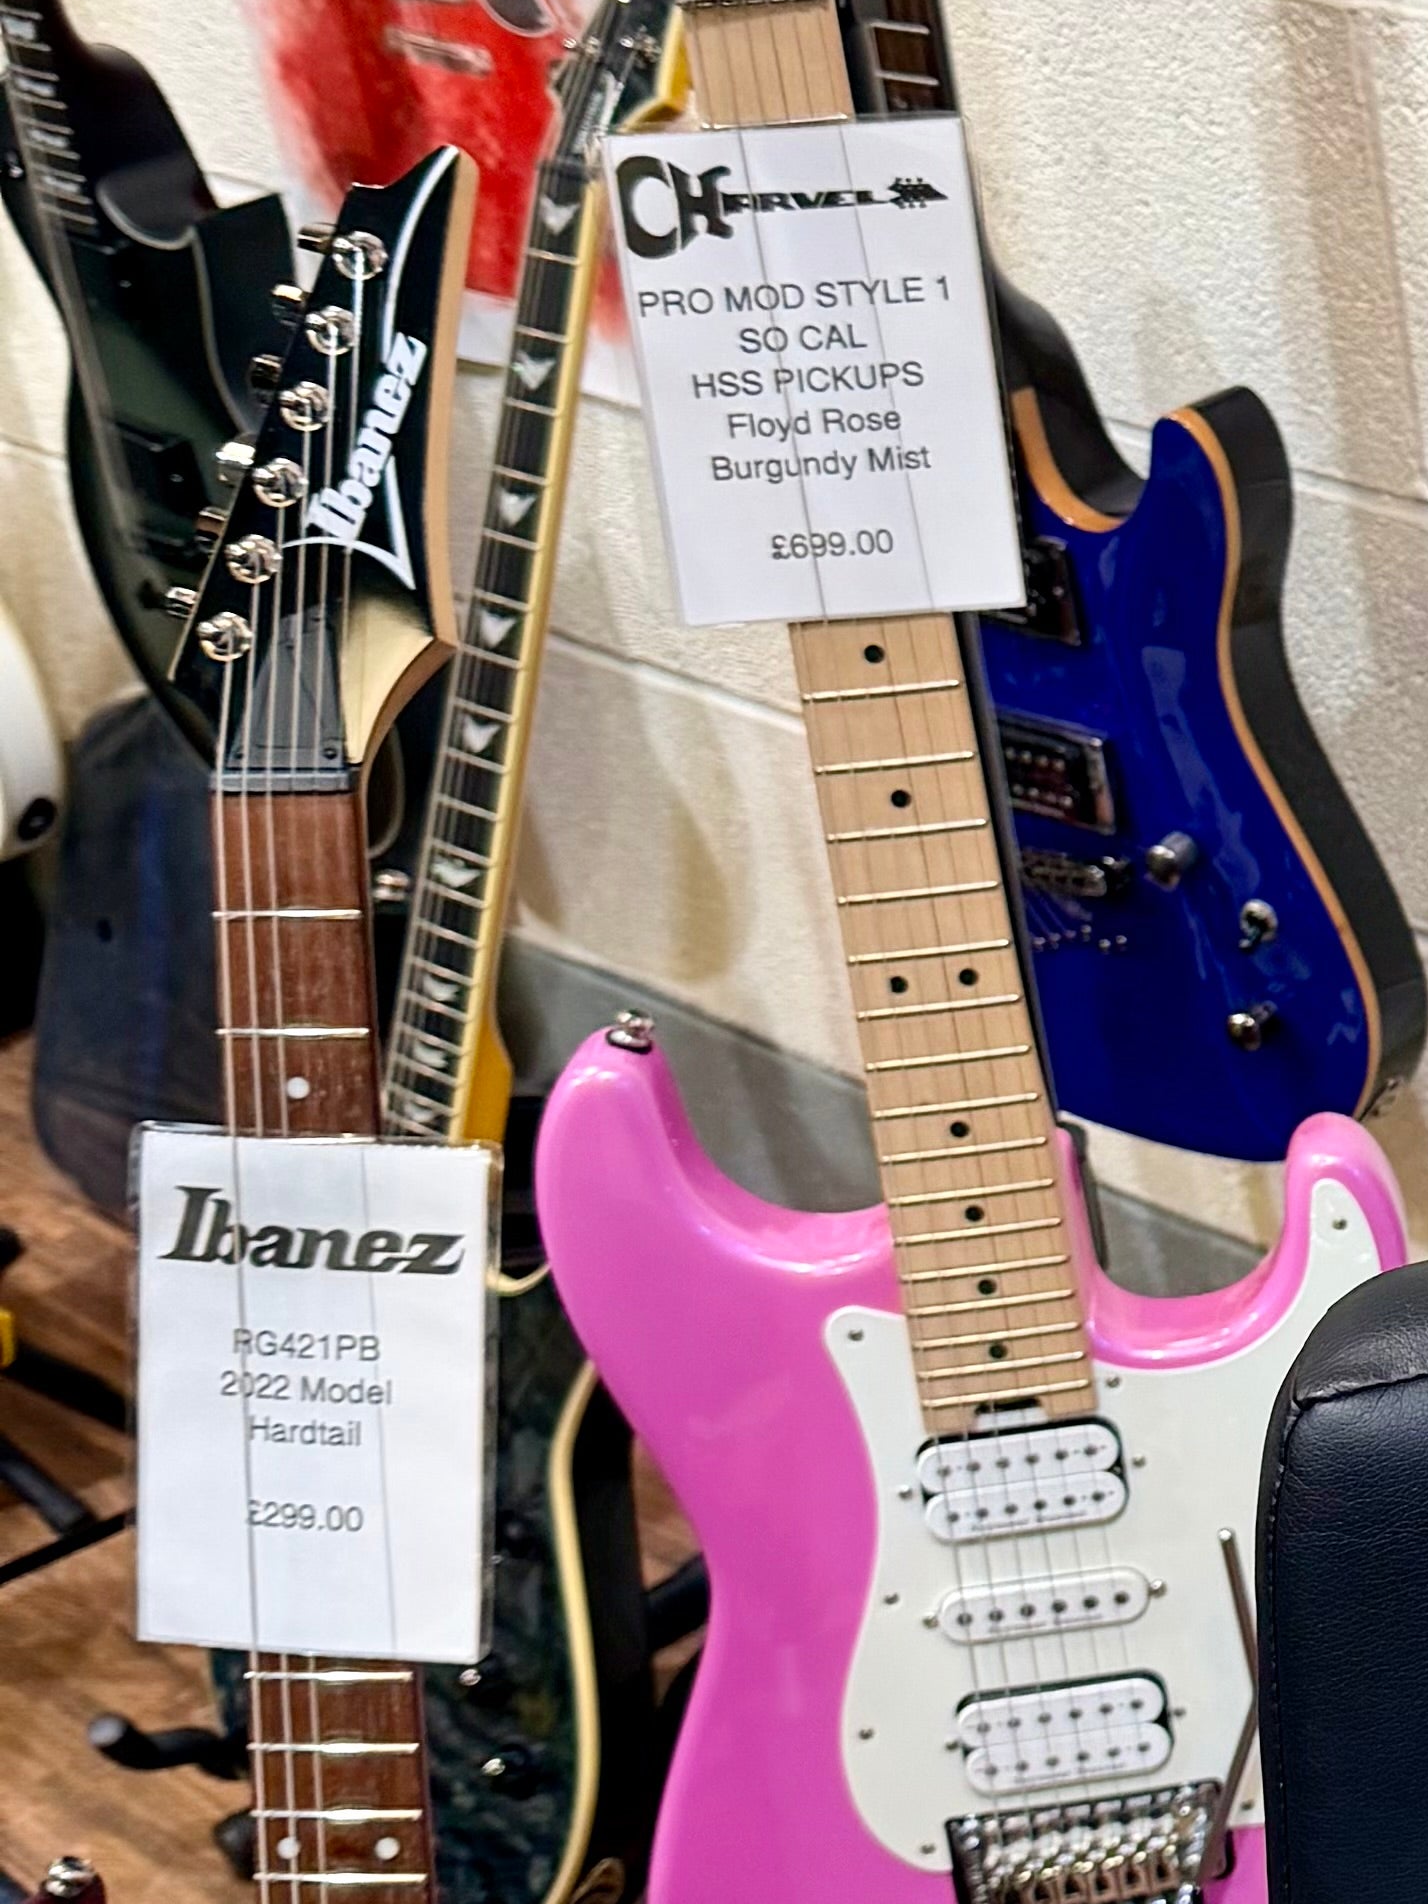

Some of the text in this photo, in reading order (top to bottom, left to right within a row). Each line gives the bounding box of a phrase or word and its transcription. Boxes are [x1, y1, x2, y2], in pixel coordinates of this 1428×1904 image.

[639, 276, 951, 317] PRO MOD STYLE 1
[739, 324, 867, 354] SO CAL
[693, 361, 924, 400] HSS PICKUPS
[303, 332, 428, 542] Ibanez
[728, 408, 901, 444] Floyd Rose
[712, 445, 932, 484] Burgundy Mist
[771, 529, 894, 560] £699.00
[158, 1184, 466, 1276] Ibanez
[232, 1327, 381, 1363] RG421PB
[220, 1370, 392, 1406] 2022 Model
[248, 1415, 362, 1448] Hardtail
[247, 1499, 364, 1533] £299.00
